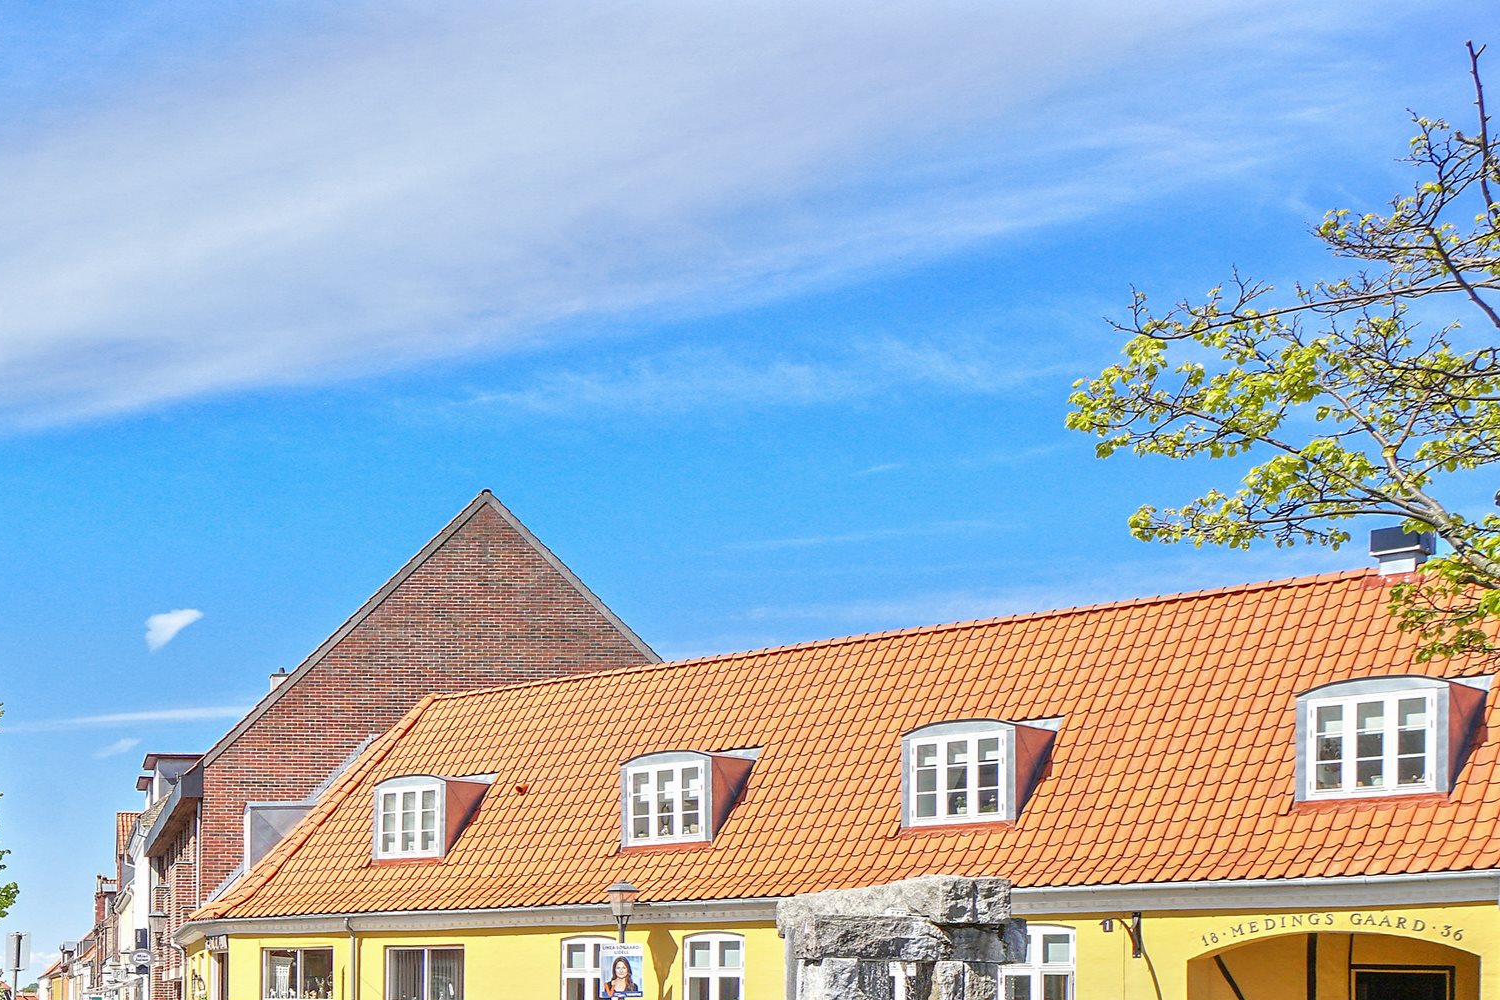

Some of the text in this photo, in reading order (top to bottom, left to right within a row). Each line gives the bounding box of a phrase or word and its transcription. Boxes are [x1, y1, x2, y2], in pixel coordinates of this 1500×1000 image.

[1201, 913, 1464, 946] 18 MEDINGS GAARD 36
